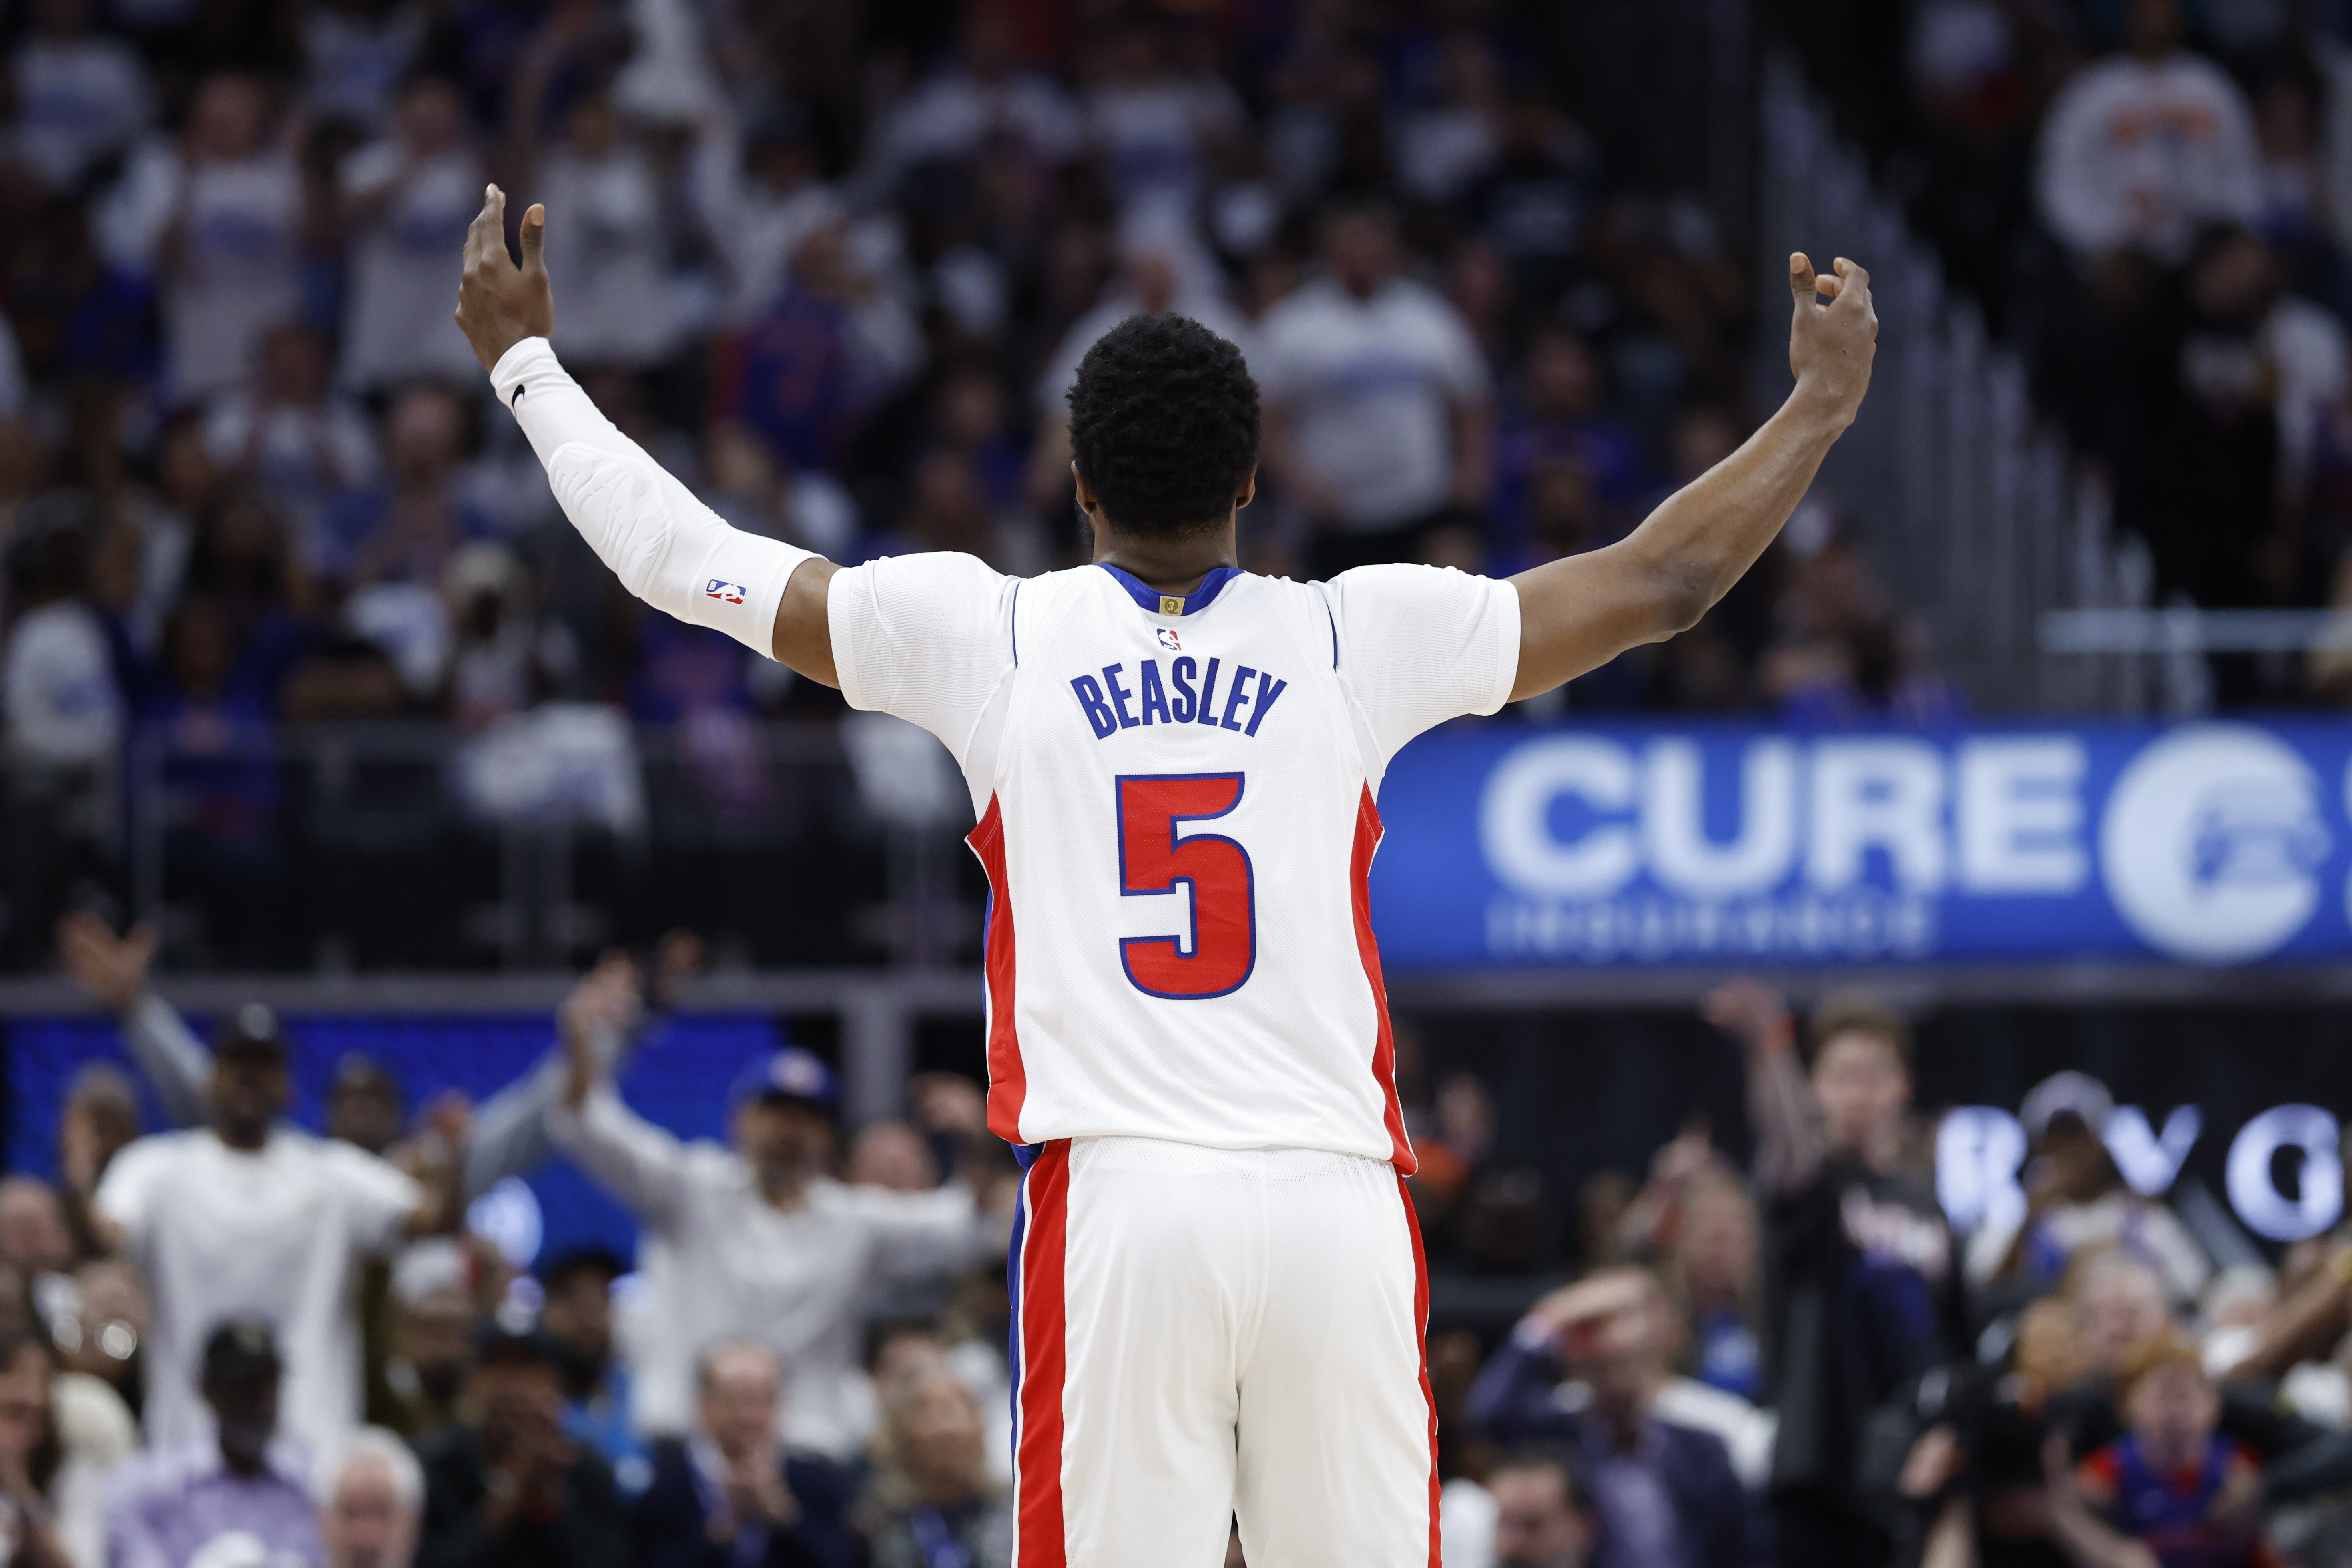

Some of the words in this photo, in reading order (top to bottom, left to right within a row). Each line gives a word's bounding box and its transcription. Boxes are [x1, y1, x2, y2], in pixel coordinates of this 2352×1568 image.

[708, 580, 718, 591] NBA
[1070, 656, 1288, 740] BEASLEY
[1481, 735, 2088, 899] CURE
[1115, 772, 1256, 1000] 5
[1485, 900, 1935, 958] INSURANCE
